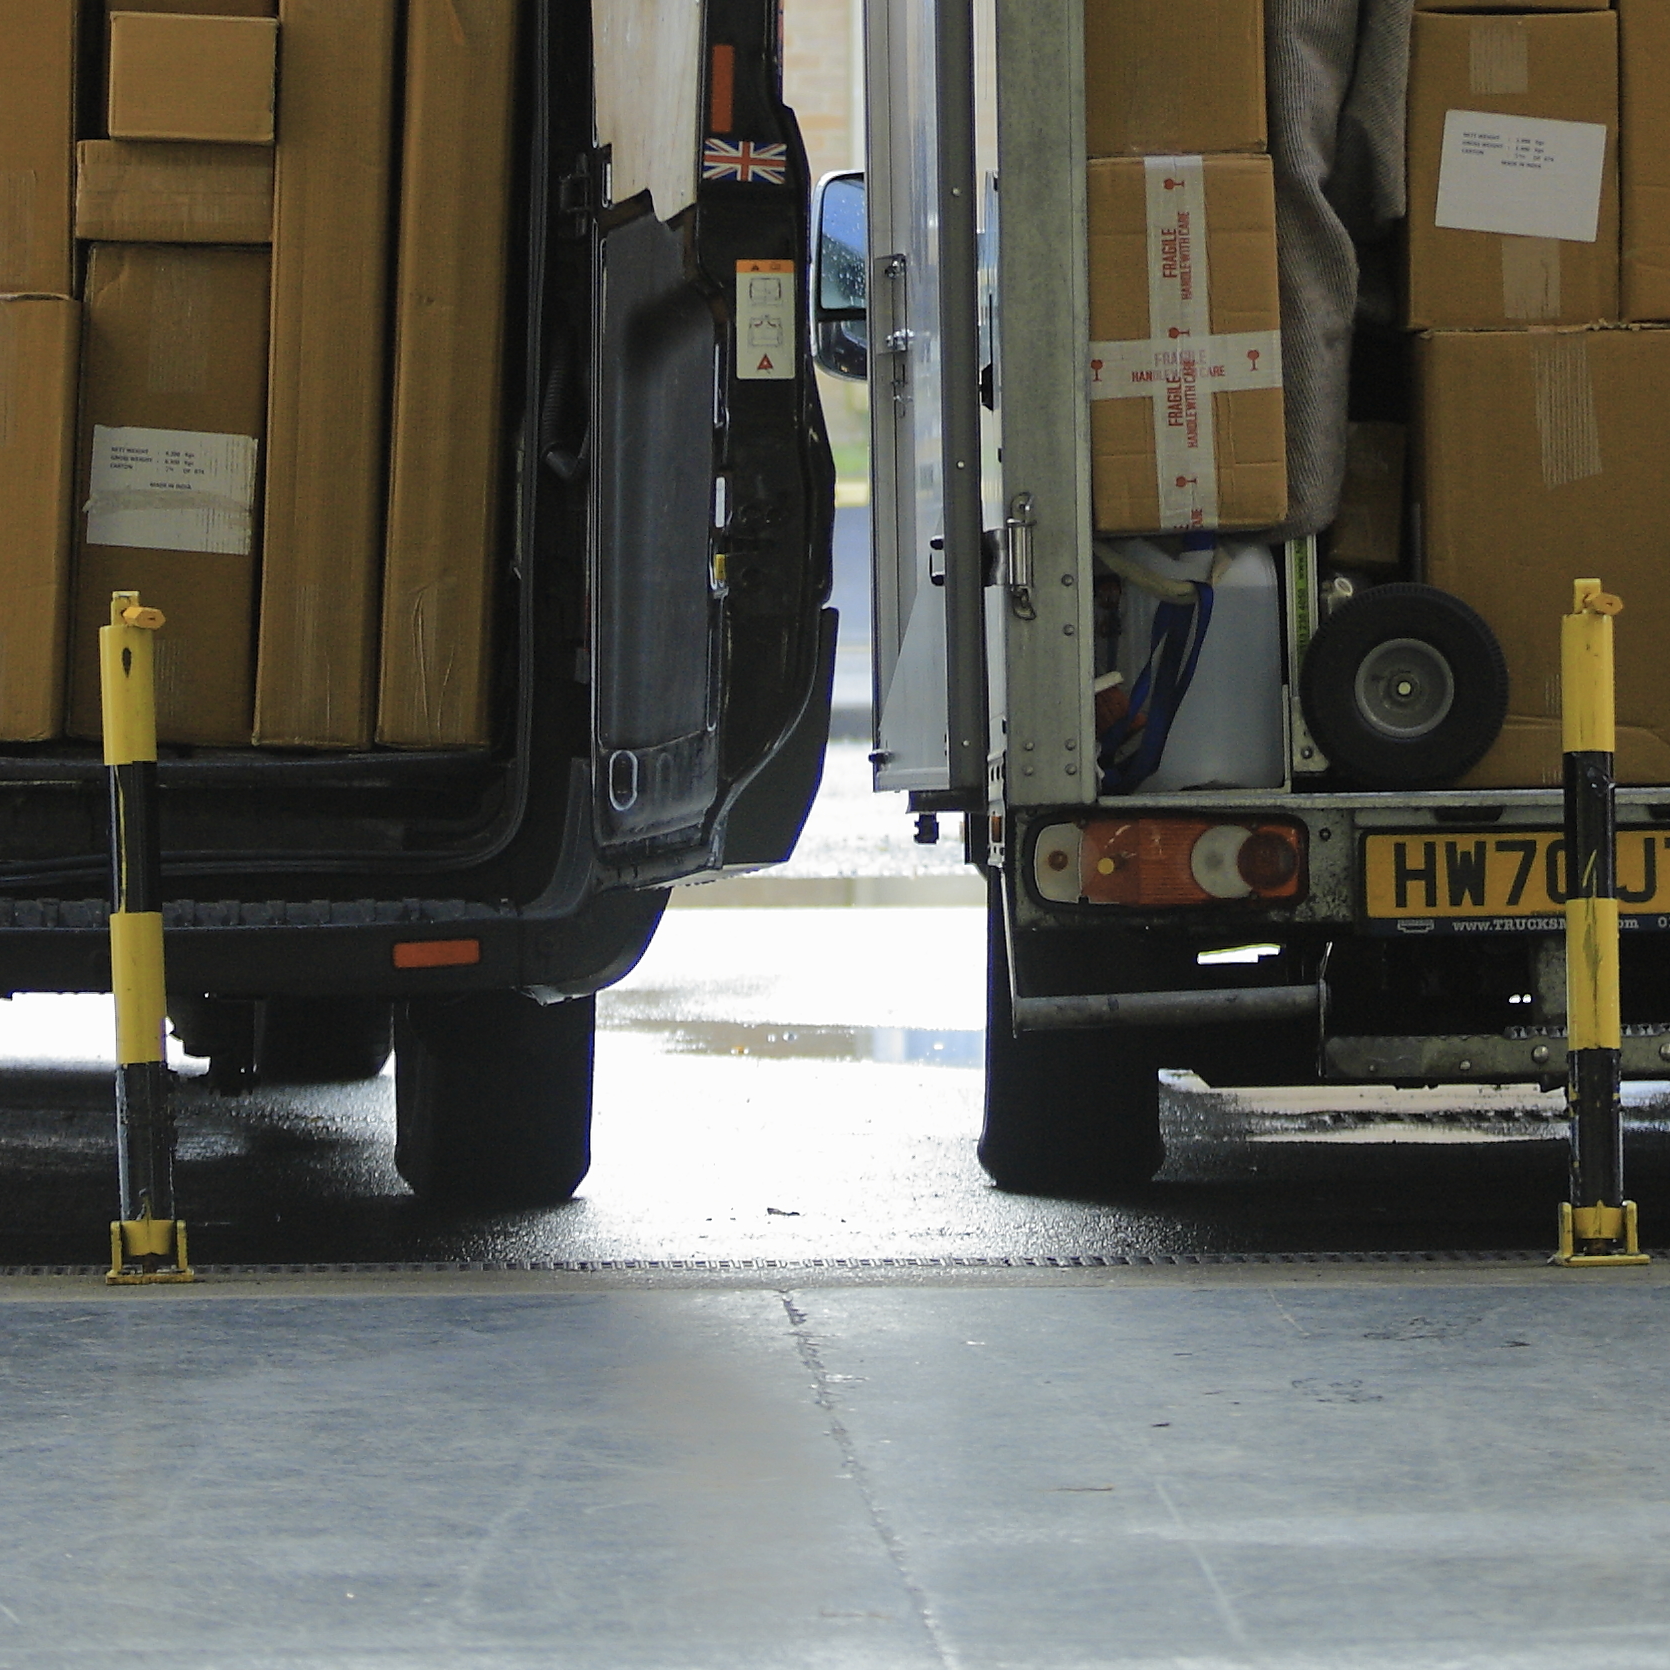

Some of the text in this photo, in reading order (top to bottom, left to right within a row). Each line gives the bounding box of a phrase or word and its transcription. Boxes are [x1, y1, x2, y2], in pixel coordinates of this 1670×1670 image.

[1178, 211, 1190, 236] CARE
[1161, 228, 1178, 279] FRAGILE
[1166, 376, 1184, 427] FRAGILE
[1451, 917, 1639, 932] www.TRUCKSom
